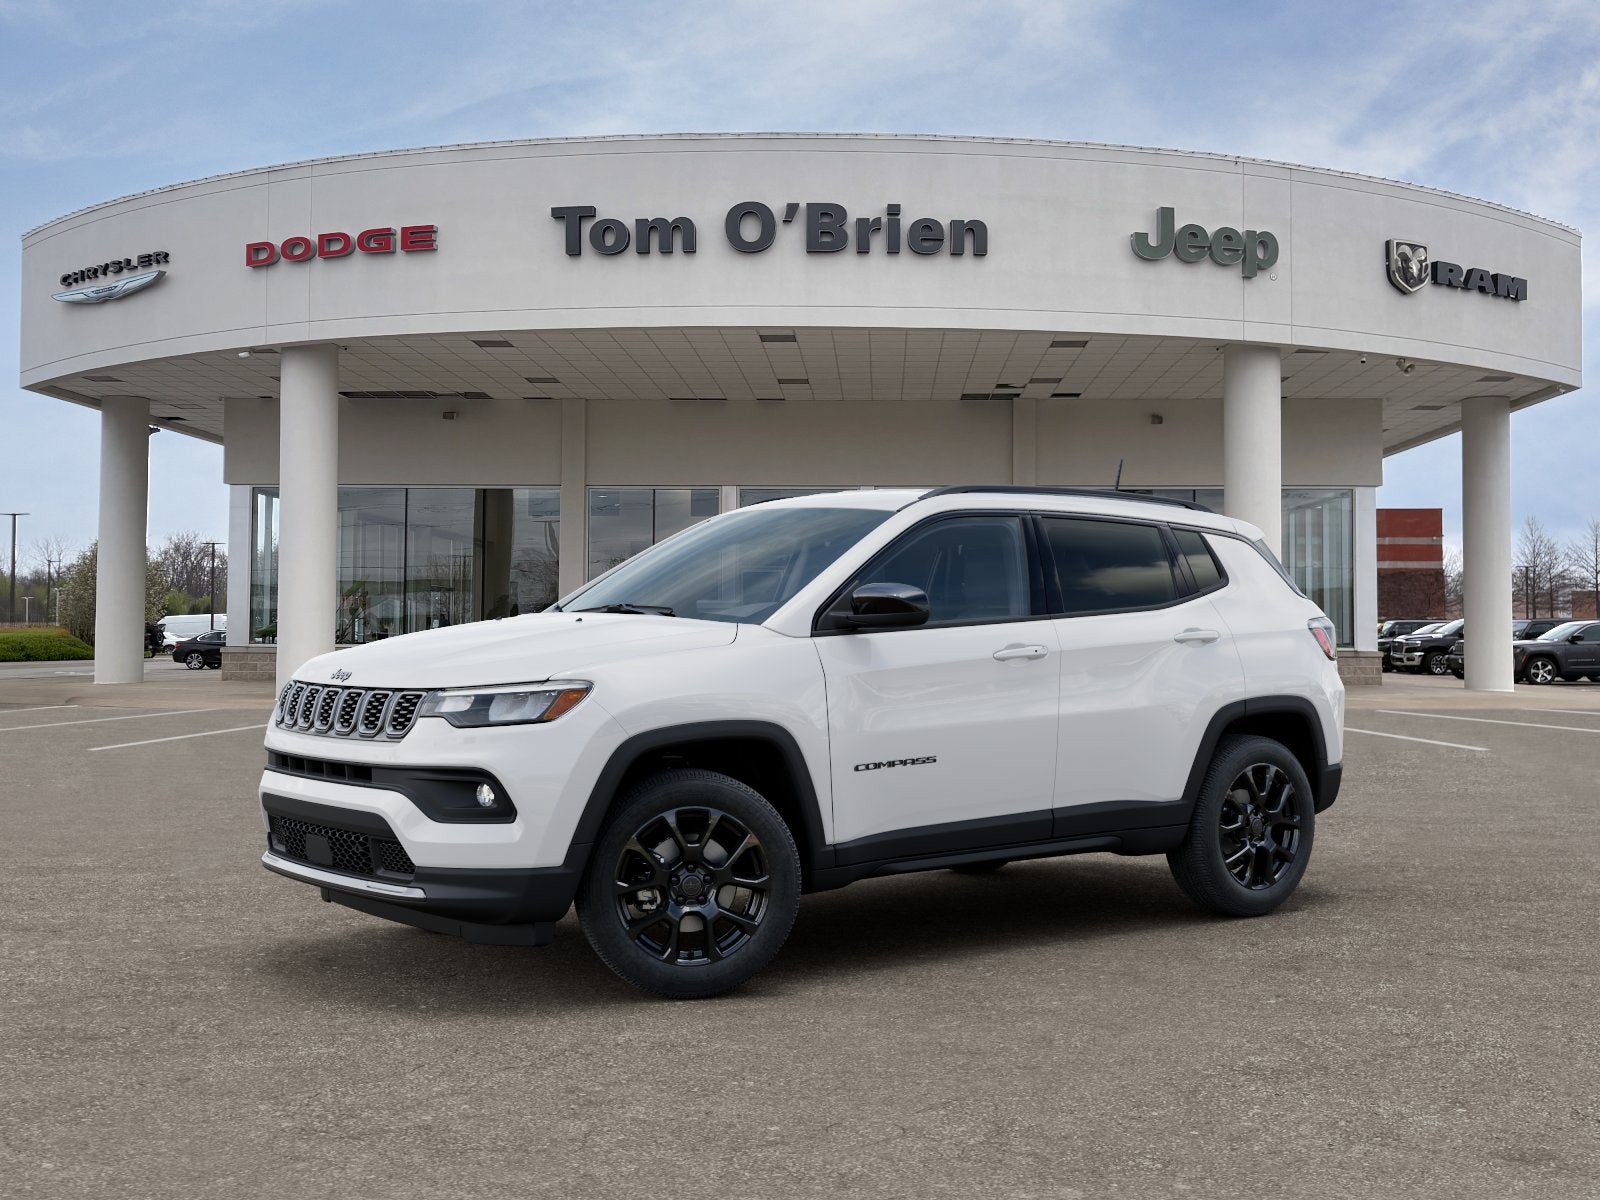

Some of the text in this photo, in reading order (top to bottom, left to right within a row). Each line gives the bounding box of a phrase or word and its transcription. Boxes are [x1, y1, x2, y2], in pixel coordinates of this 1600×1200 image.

[245, 224, 438, 268] DODGE
[551, 201, 988, 256] Tom O'Brien
[1130, 206, 1279, 279] Jeep
[60, 251, 169, 287] CHRYSLER
[1431, 260, 1527, 301] RAM
[330, 668, 352, 682] Jeep
[853, 755, 937, 772] COMPASS
